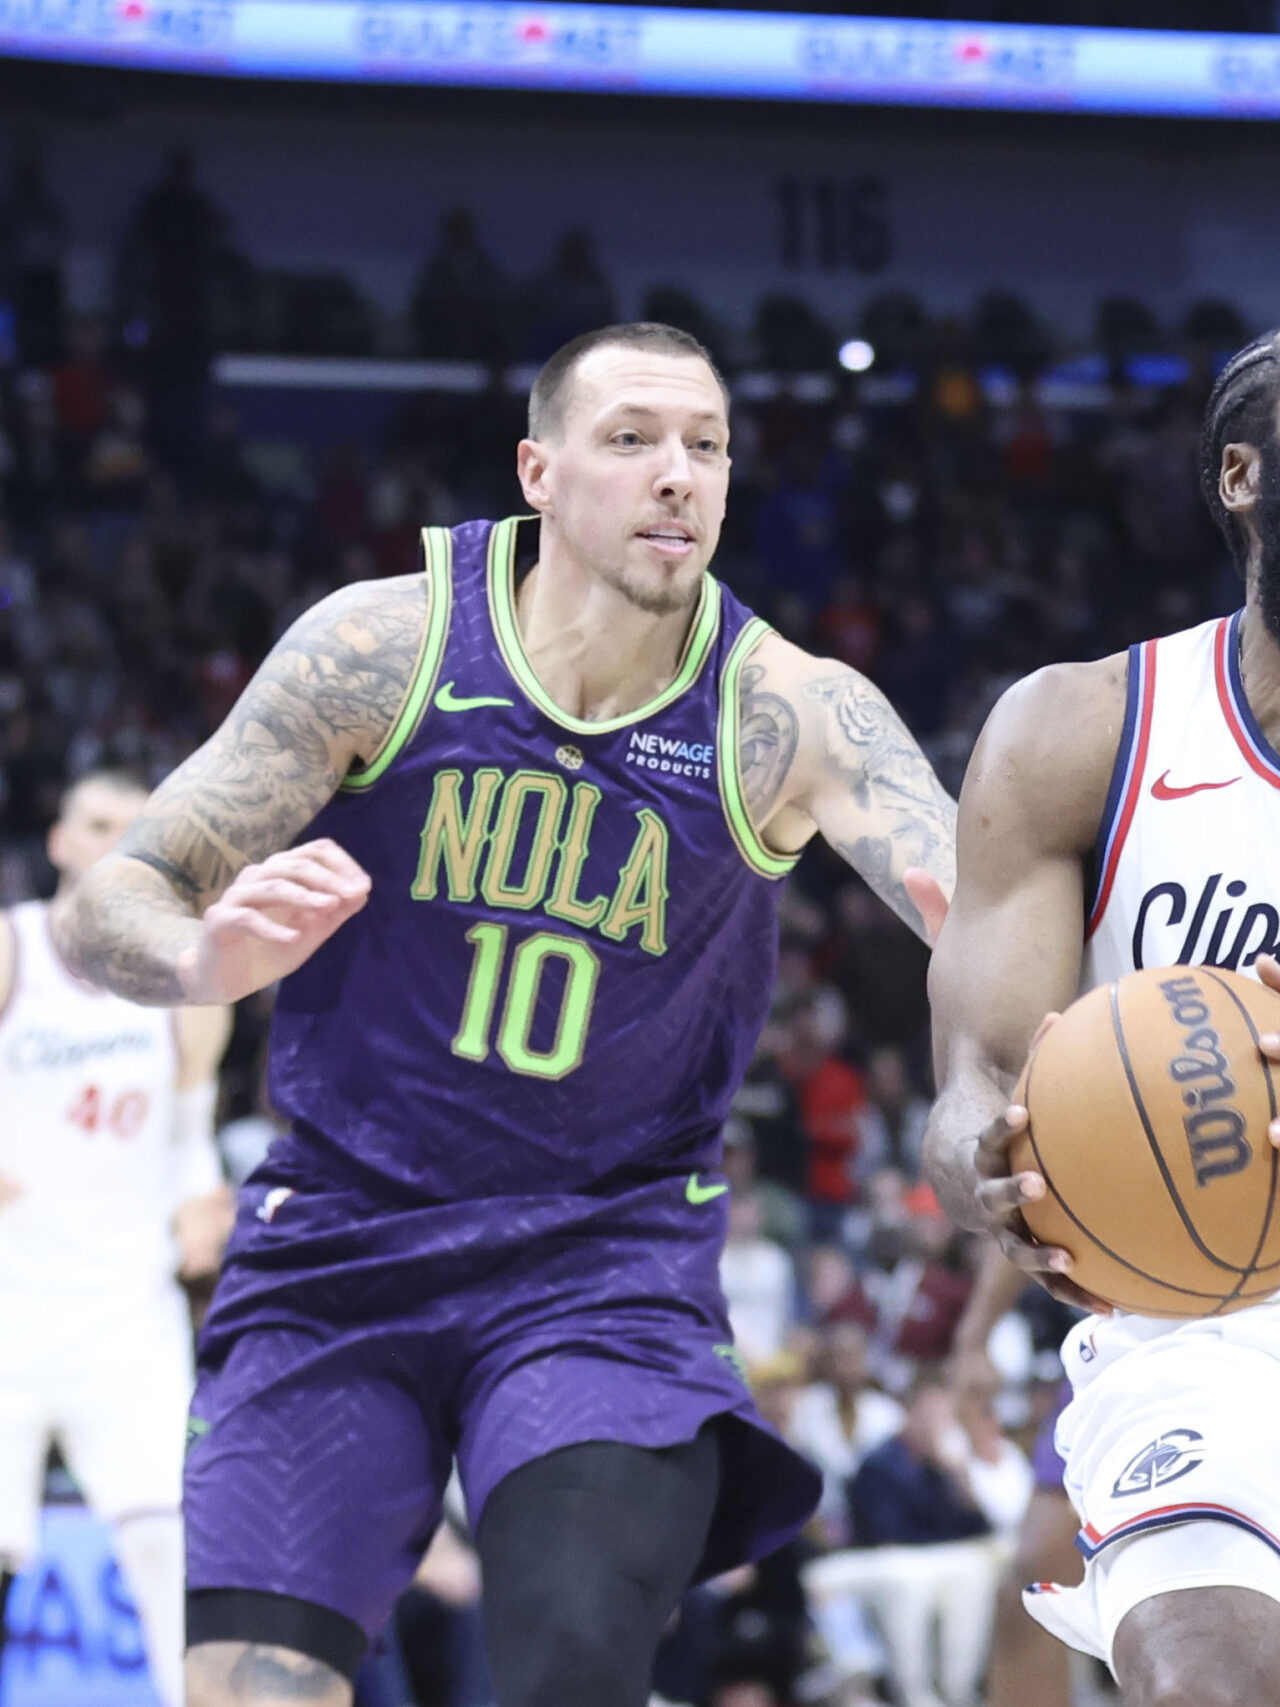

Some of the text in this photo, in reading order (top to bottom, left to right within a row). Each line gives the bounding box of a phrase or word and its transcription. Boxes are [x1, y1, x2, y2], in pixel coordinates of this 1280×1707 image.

[626, 752, 710, 779] PRODUCTS
[629, 731, 714, 764] NEWAGE
[411, 768, 669, 956] NOLA
[451, 922, 601, 1081] 10
[1158, 976, 1253, 1189] Wilson
